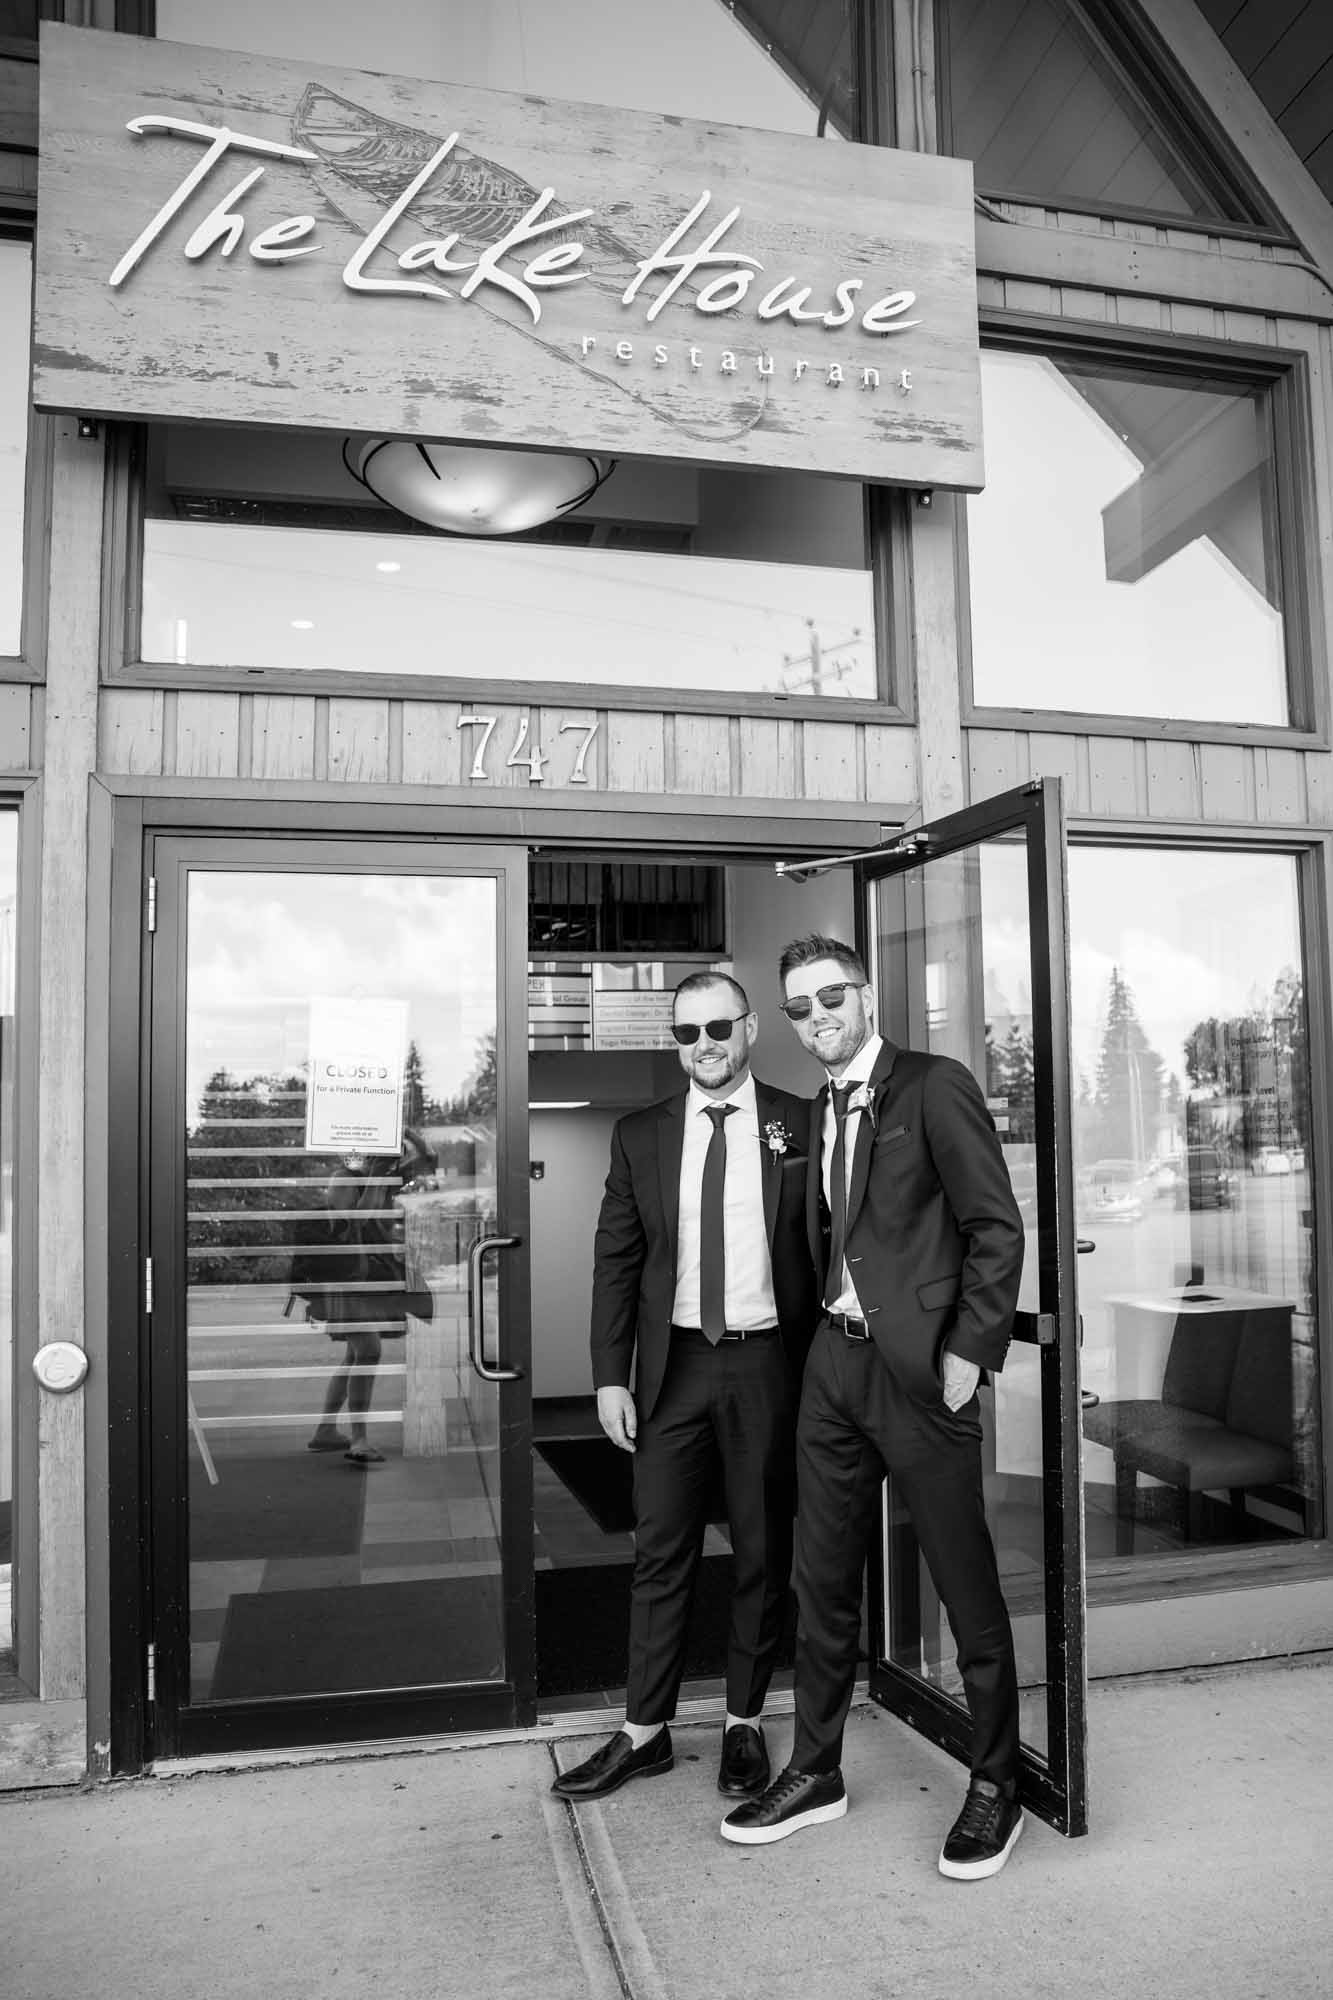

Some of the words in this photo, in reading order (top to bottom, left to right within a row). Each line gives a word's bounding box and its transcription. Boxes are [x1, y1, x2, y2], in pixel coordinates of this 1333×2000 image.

[108, 115, 322, 288] The
[342, 131, 595, 325] Lake
[621, 189, 925, 334] House
[581, 334, 914, 390] restaurant
[456, 715, 600, 783] 747
[316, 1083, 328, 1093] for
[335, 1084, 361, 1094] Private
[363, 1085, 396, 1096] Function
[326, 1064, 388, 1079] CLOSED
